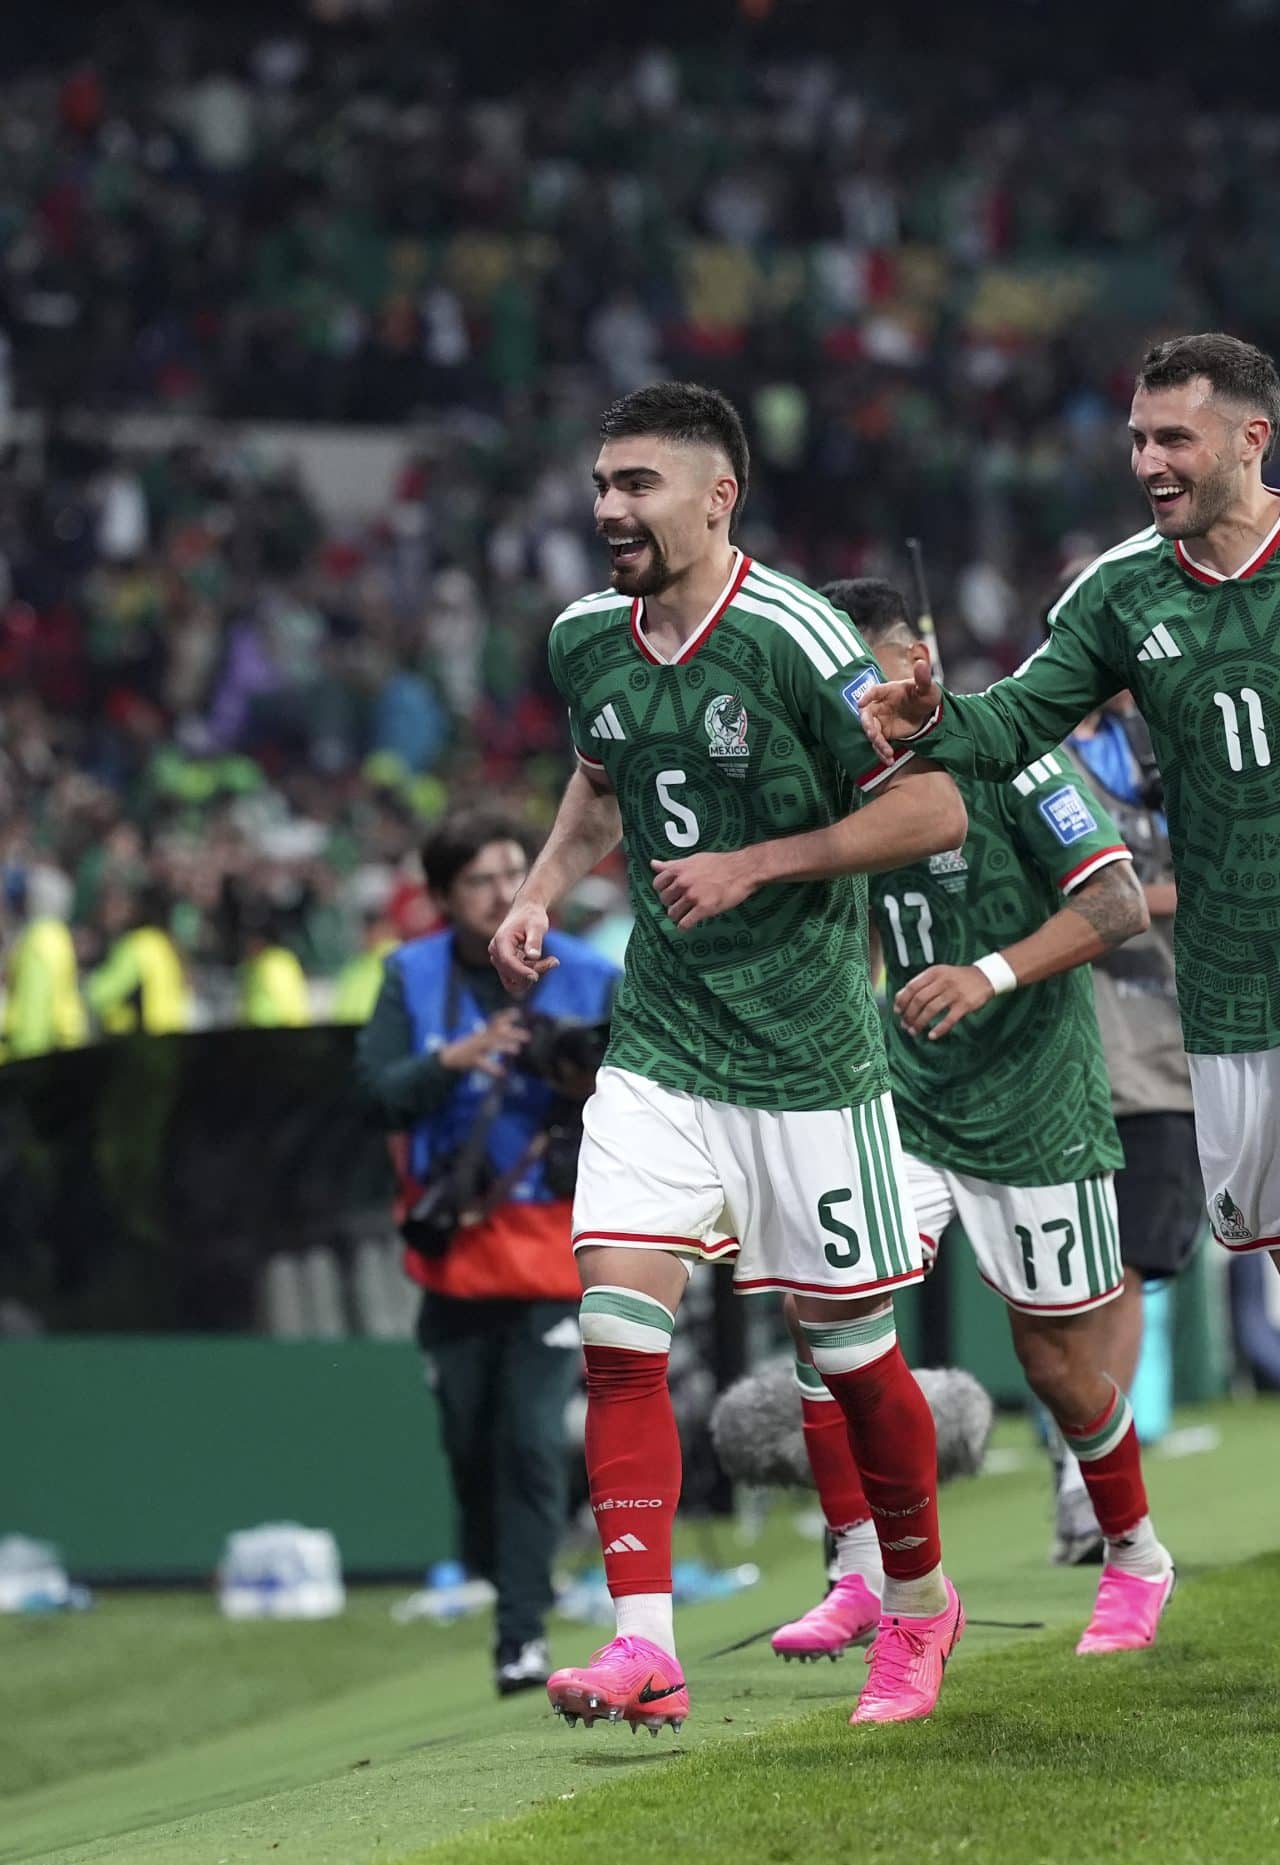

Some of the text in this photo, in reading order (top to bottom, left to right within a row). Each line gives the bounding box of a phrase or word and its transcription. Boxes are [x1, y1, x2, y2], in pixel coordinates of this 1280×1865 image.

[1213, 687, 1271, 772] 11
[655, 769, 700, 848] 5
[883, 892, 934, 967] 17
[817, 1187, 861, 1269] 5
[1014, 1218, 1076, 1291] 17
